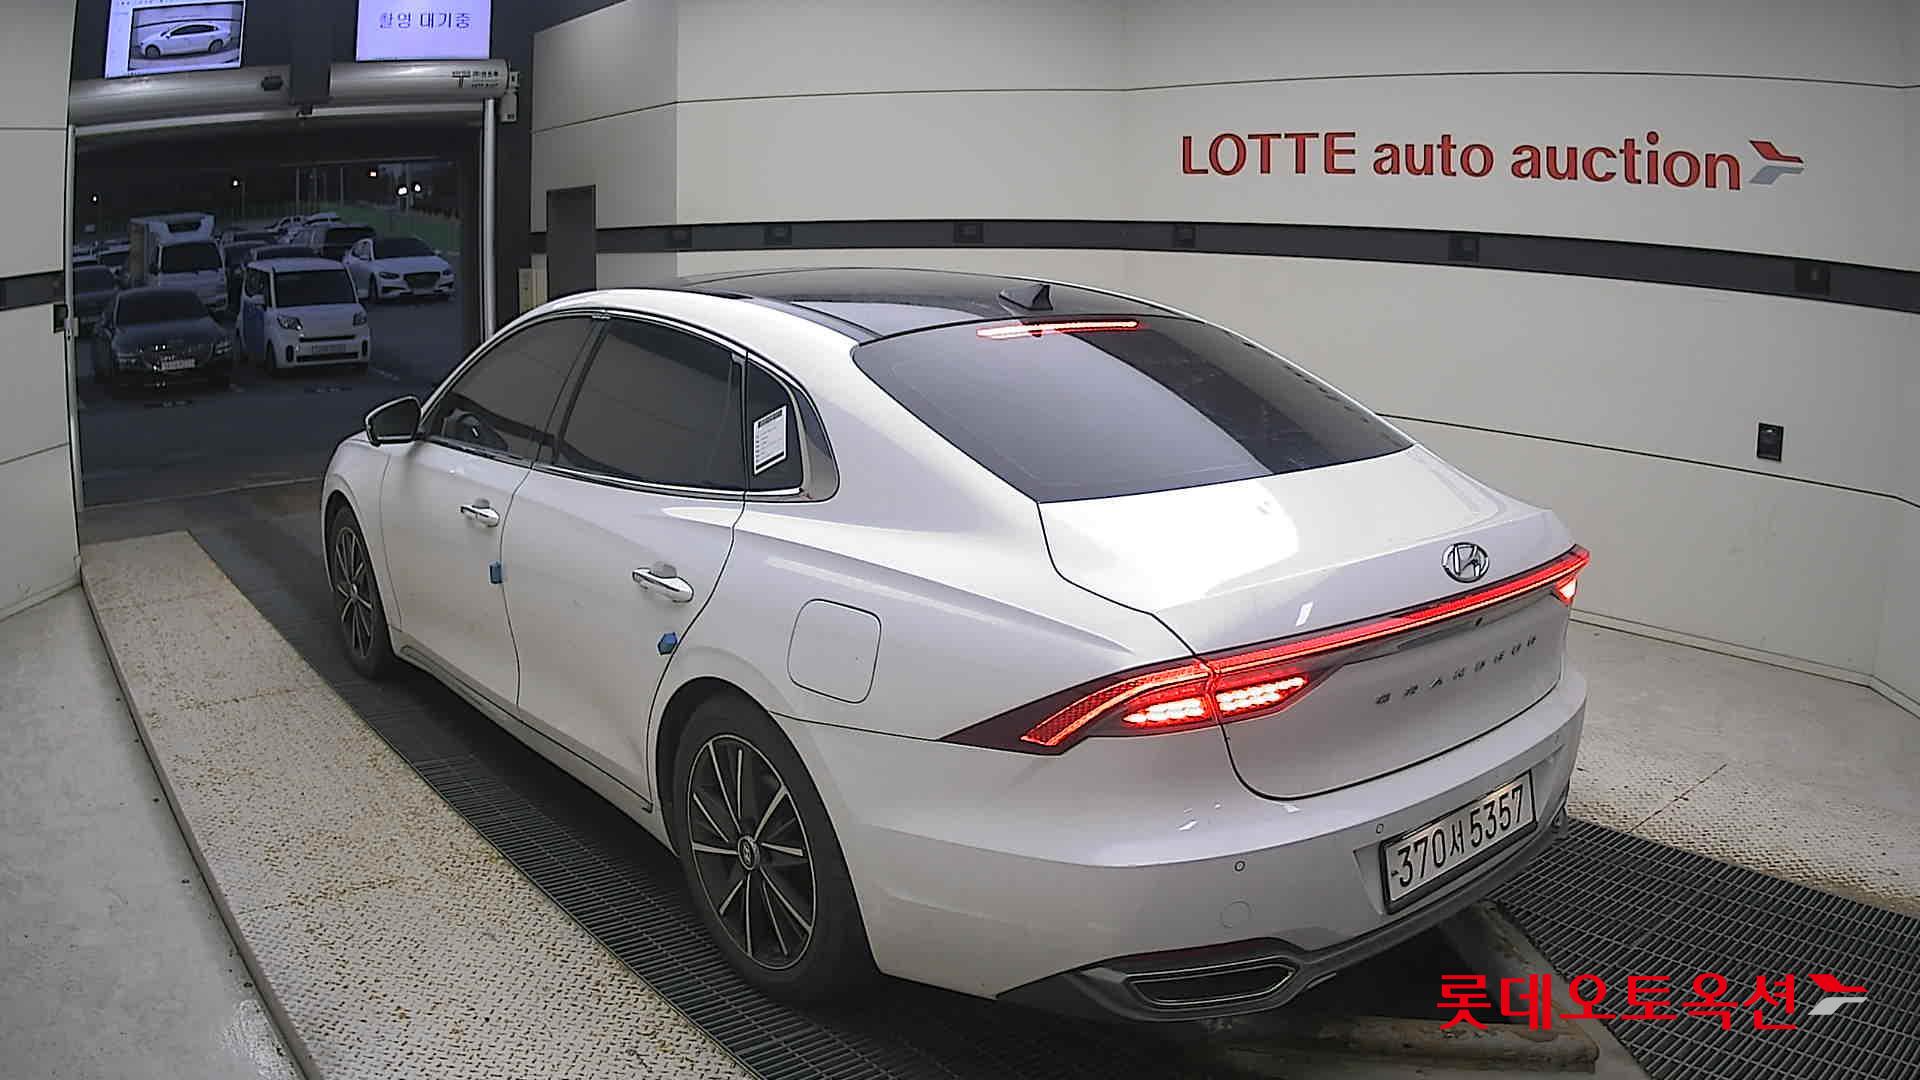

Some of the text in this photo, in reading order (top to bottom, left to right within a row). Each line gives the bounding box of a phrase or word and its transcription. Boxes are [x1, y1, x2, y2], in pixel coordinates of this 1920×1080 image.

[419, 12, 472, 29] 대기중
[1181, 131, 1741, 190] LOTTE auto auction
[1398, 784, 1523, 887] 370서 5357
